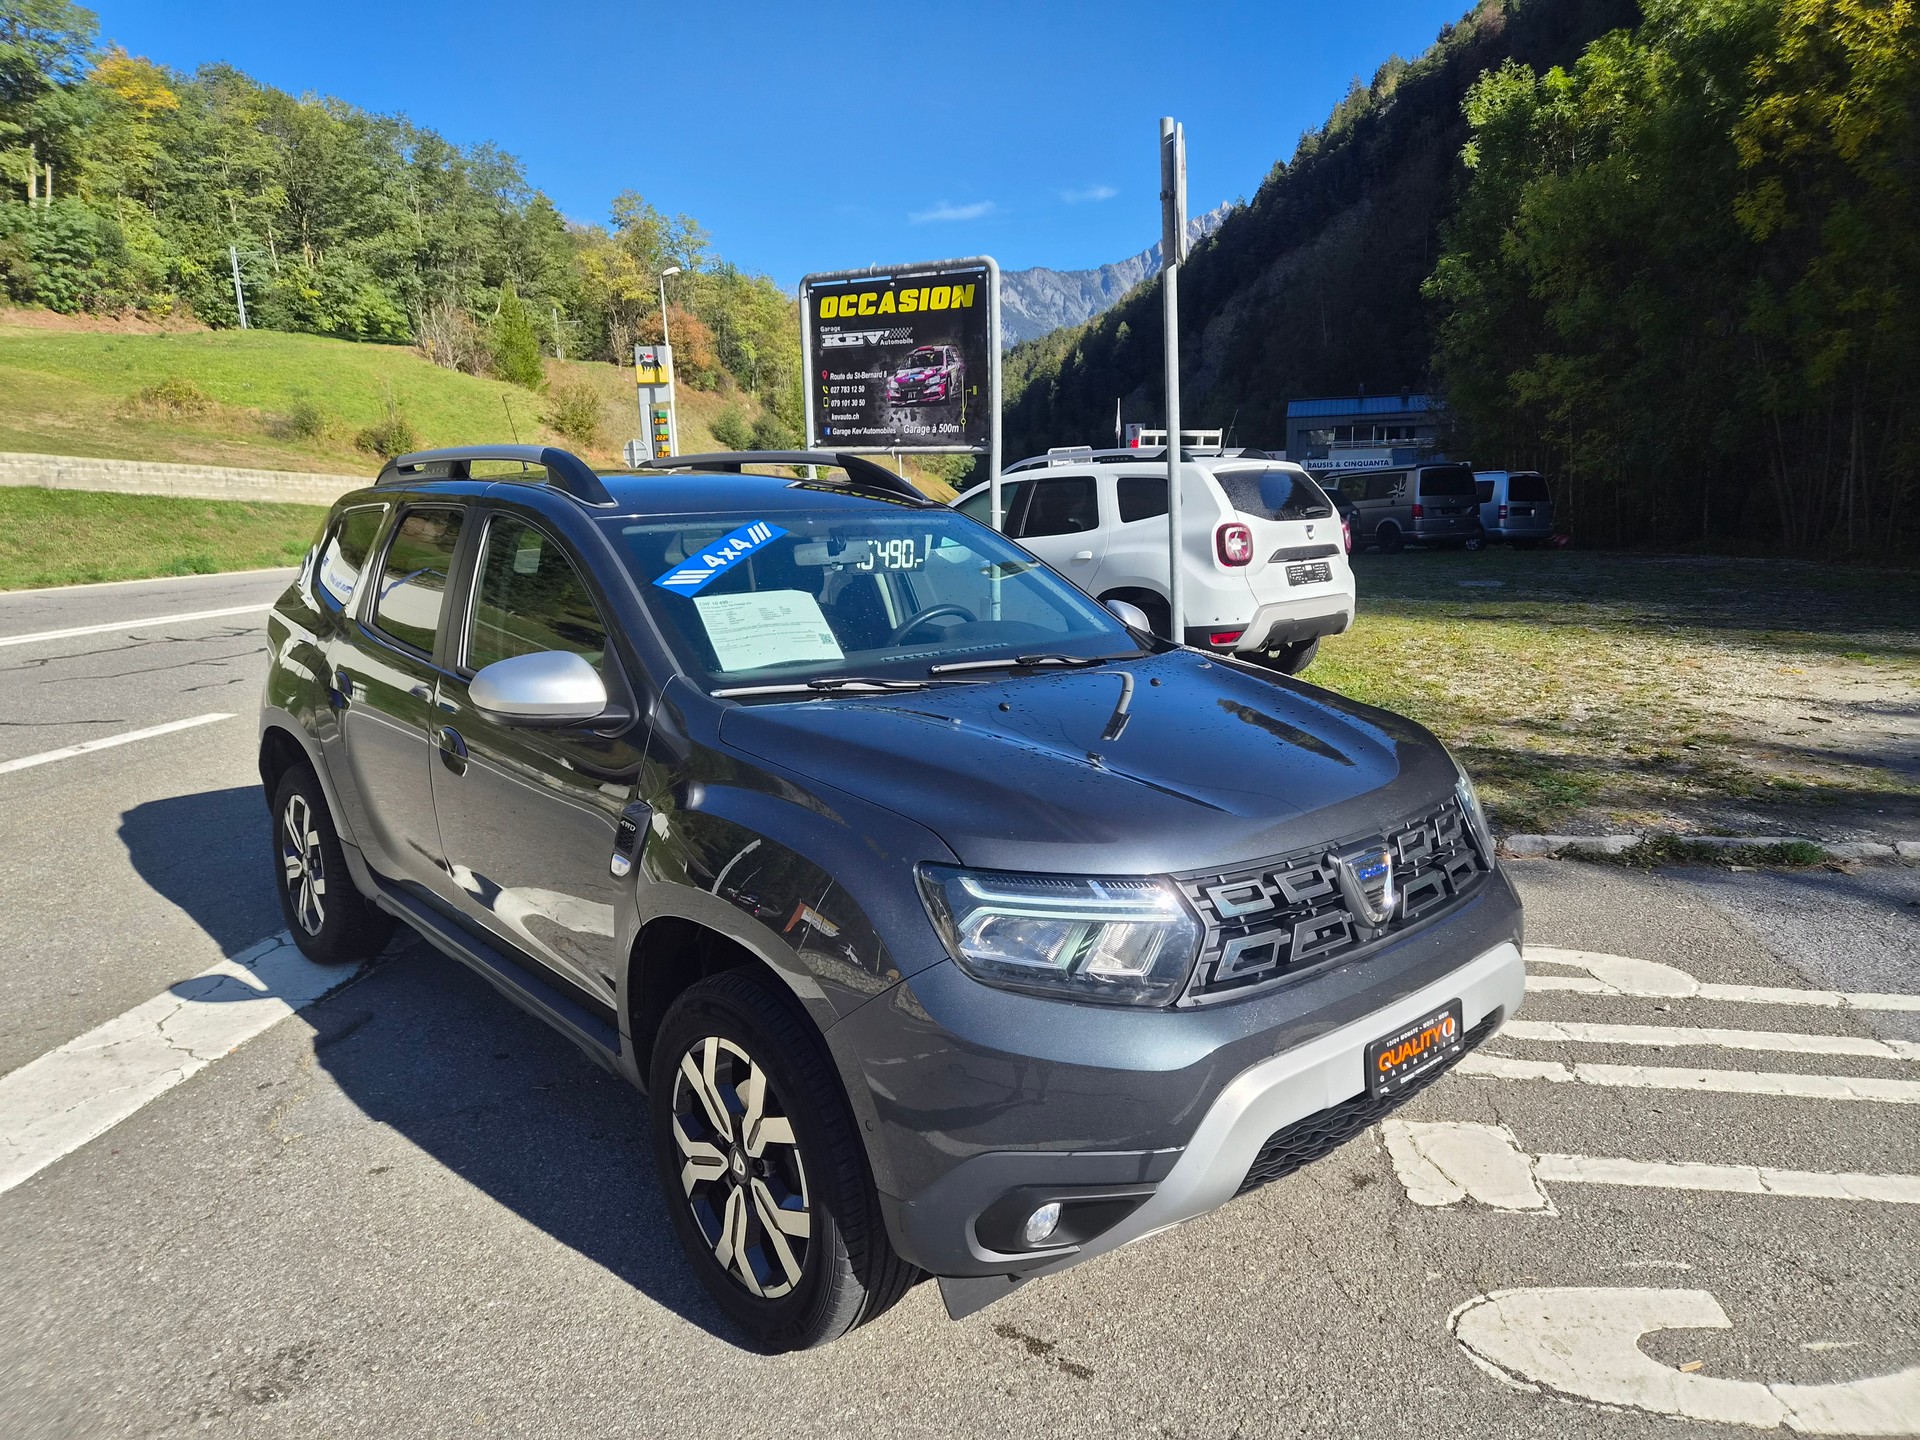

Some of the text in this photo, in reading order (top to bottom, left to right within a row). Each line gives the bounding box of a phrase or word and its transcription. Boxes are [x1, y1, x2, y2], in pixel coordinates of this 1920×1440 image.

[819, 284, 975, 318] OCCASION
[854, 371, 882, 379] St-Bernard
[832, 428, 851, 436] Garage
[904, 424, 960, 436] Garage à 500m
[702, 538, 753, 568] 4x4
[620, 820, 636, 832] 4WD
[1400, 1026, 1418, 1040] MONATE
[1380, 1036, 1455, 1082] GARANTIE
